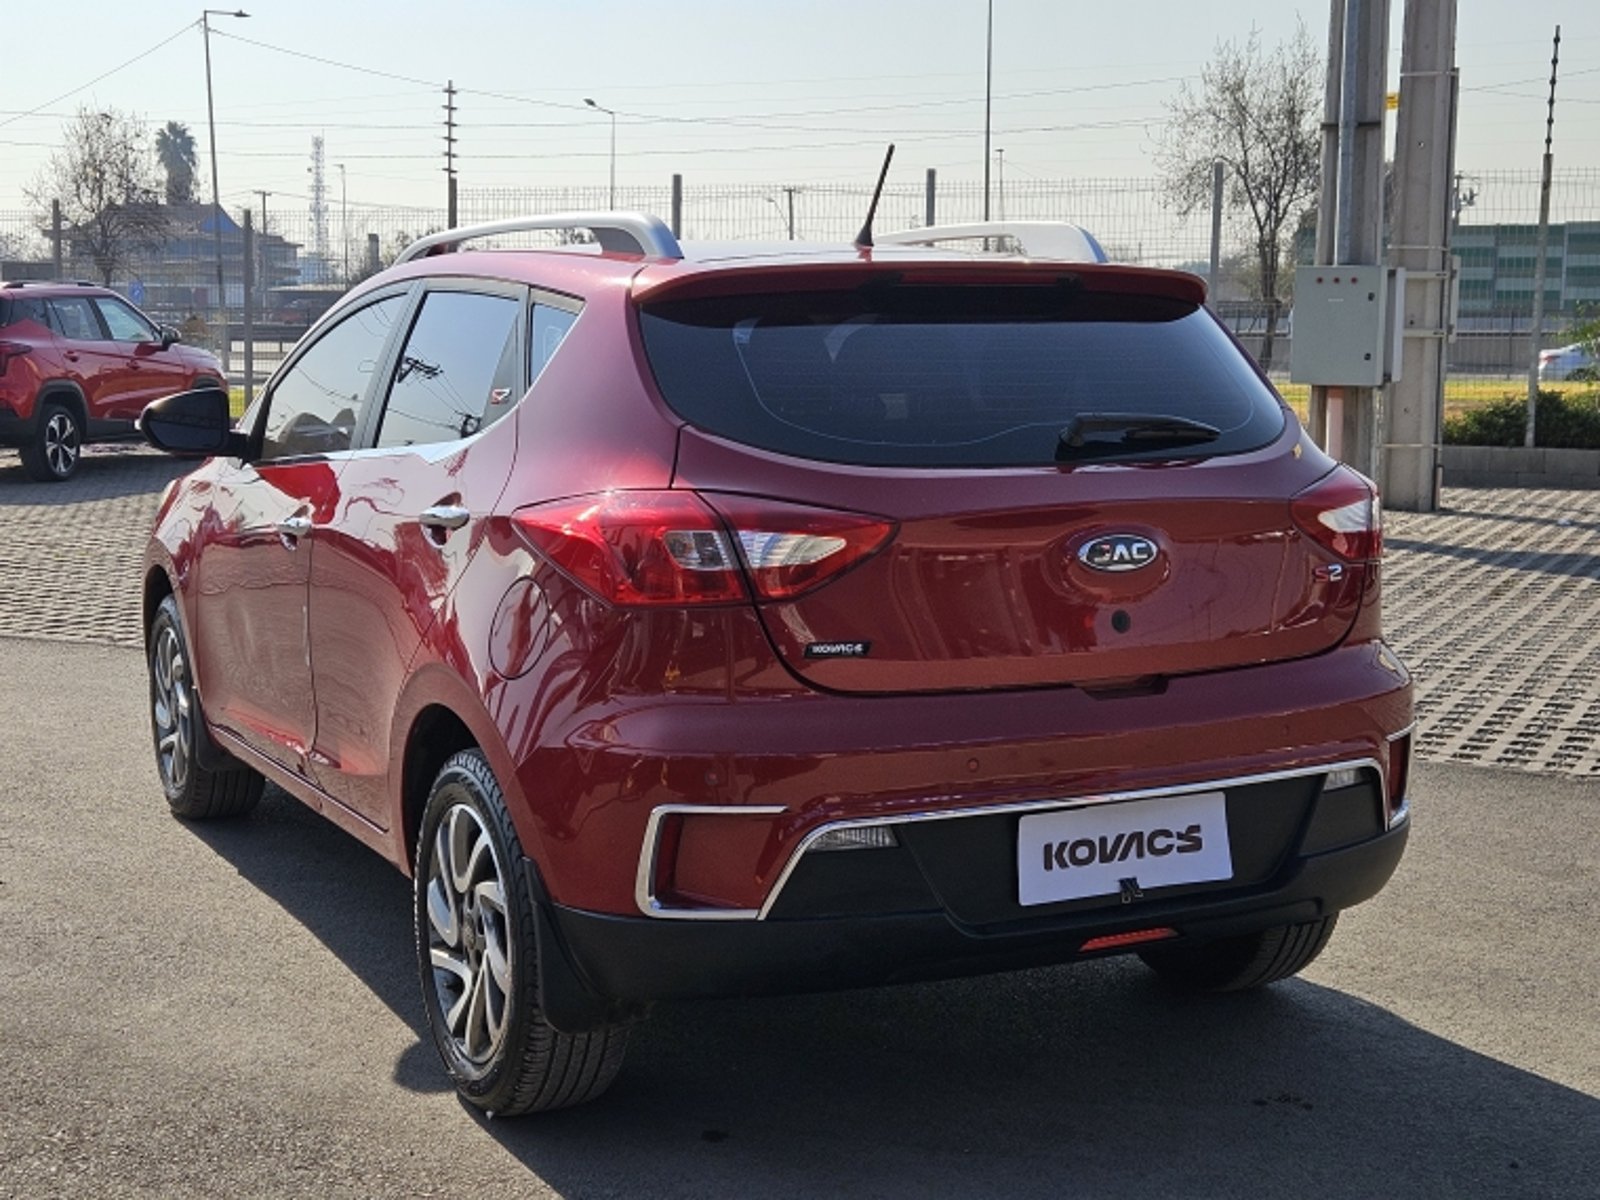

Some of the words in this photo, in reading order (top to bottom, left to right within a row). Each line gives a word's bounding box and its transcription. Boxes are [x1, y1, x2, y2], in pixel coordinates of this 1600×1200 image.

[1093, 542, 1149, 562] JAC
[1315, 563, 1342, 582] S2
[1043, 824, 1203, 872] KOVACS
